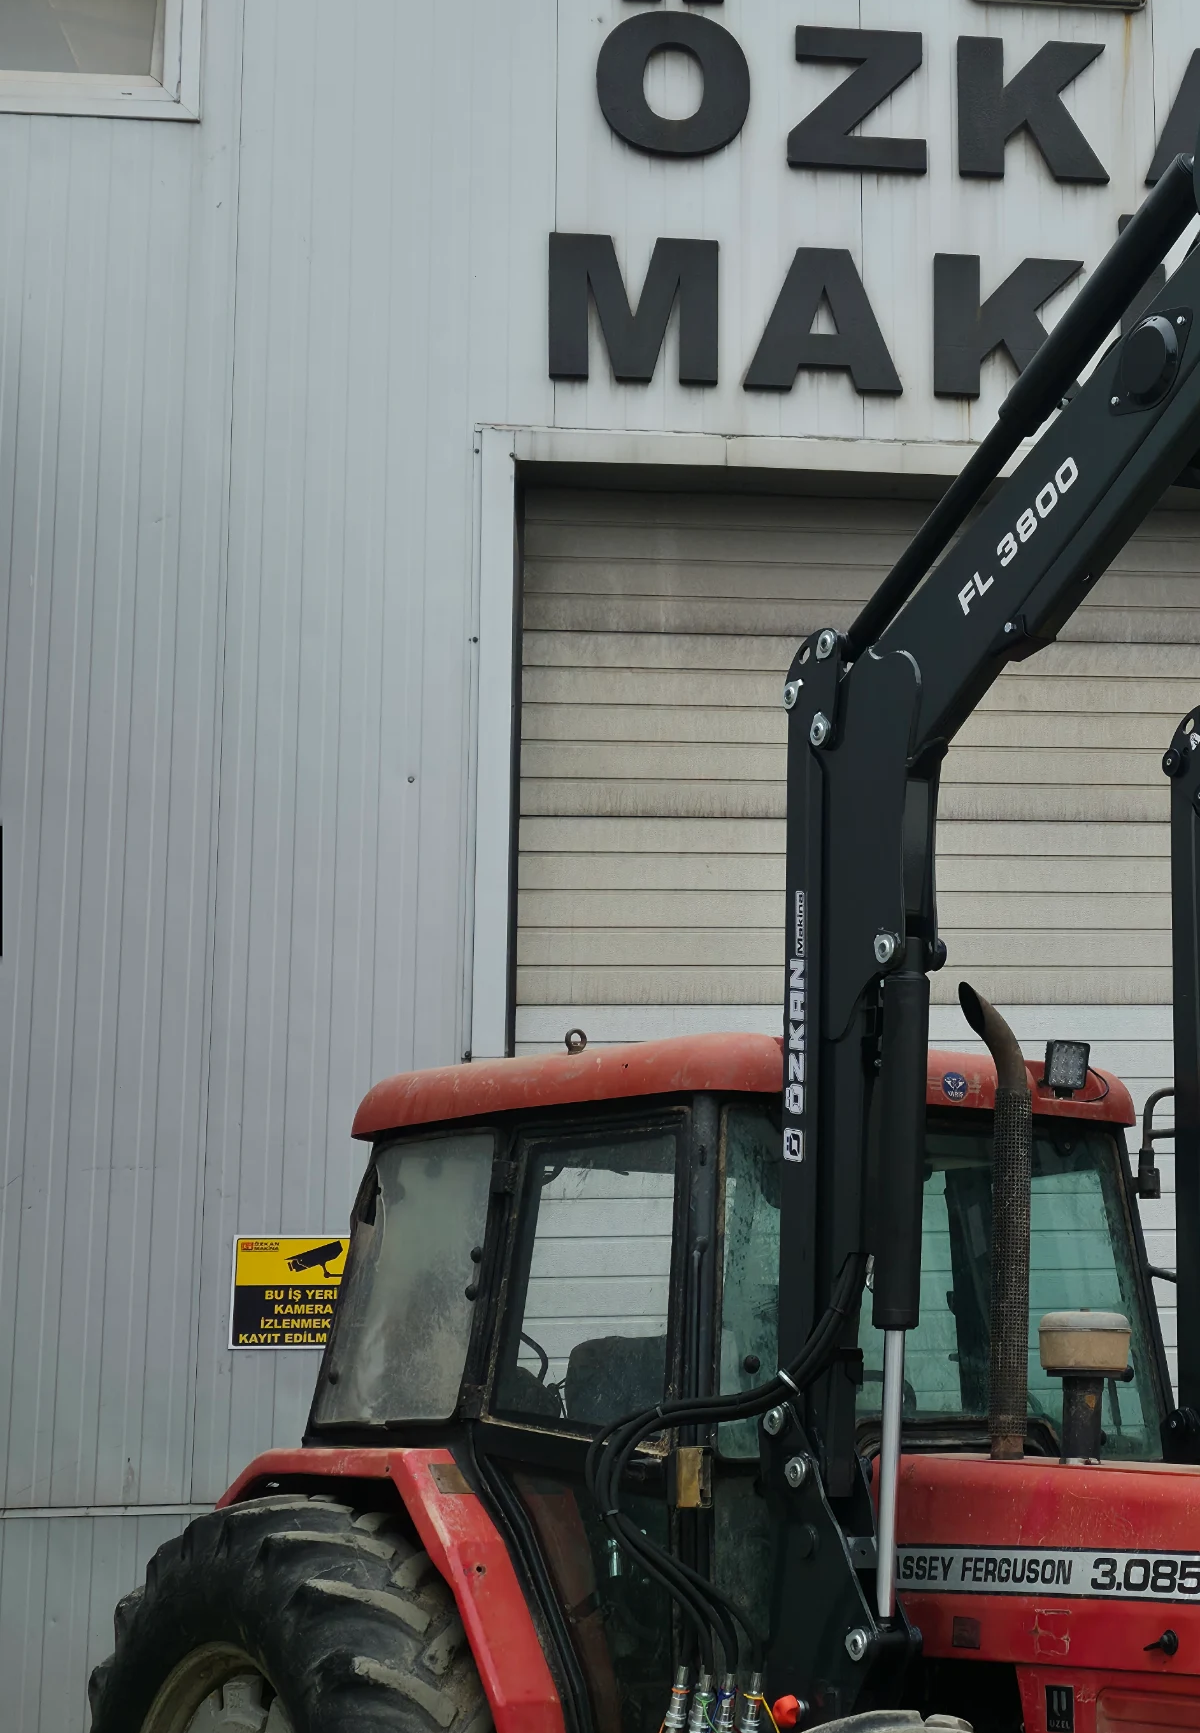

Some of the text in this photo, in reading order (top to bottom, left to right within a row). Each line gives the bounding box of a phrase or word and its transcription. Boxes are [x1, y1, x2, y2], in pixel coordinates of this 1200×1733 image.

[957, 456, 1079, 616] FL 3800
[785, 958, 805, 1115] ÖZKAN
[796, 892, 804, 956] Makina
[264, 1288, 338, 1302] BU İŞ YERİ
[274, 1304, 334, 1314] KAMERA
[238, 1333, 280, 1344] KAYIT
[960, 1557, 1073, 1585] FERGUSON
[1049, 1719, 1071, 1729] UZEL
